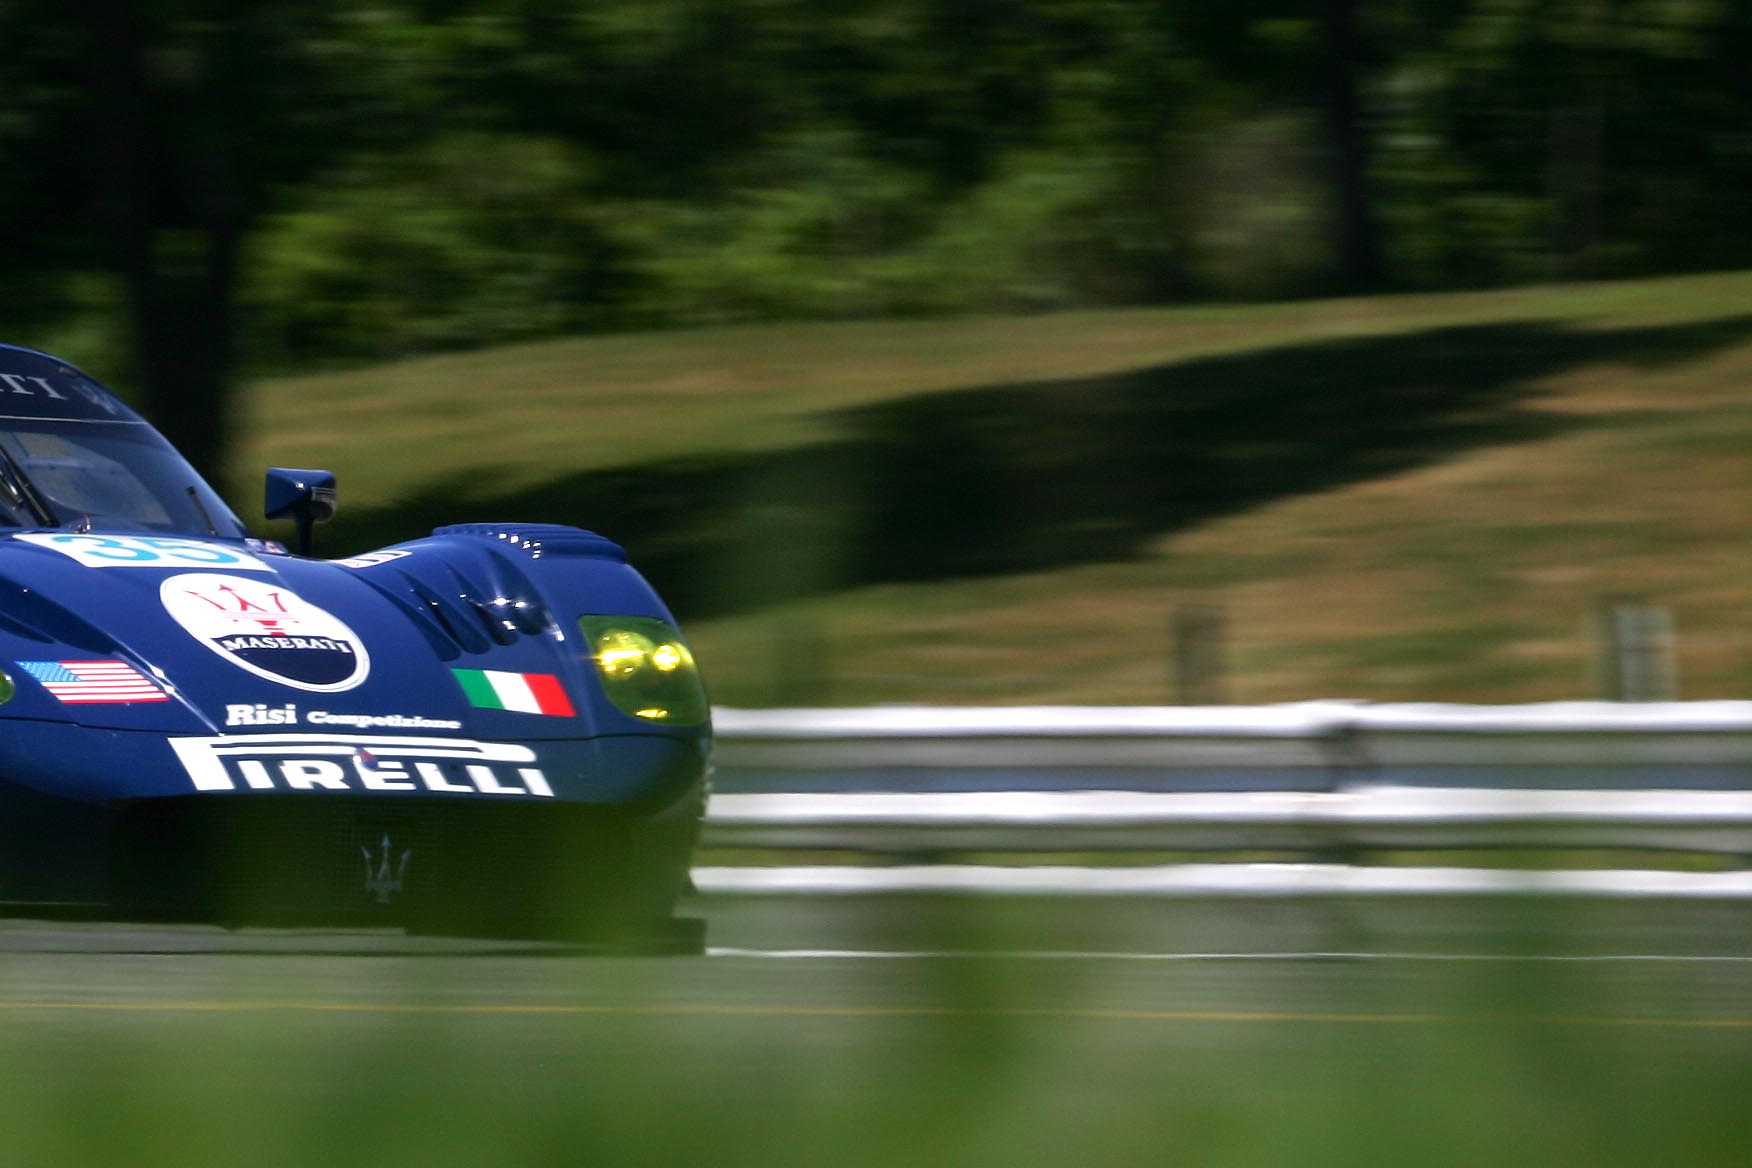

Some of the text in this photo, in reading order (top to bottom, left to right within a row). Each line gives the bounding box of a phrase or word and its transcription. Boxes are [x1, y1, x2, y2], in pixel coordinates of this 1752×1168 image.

[51, 536, 240, 564] 35
[222, 636, 352, 654] MASERATI
[225, 704, 462, 729] Risi Competizione
[168, 734, 555, 797] PIRELLI
